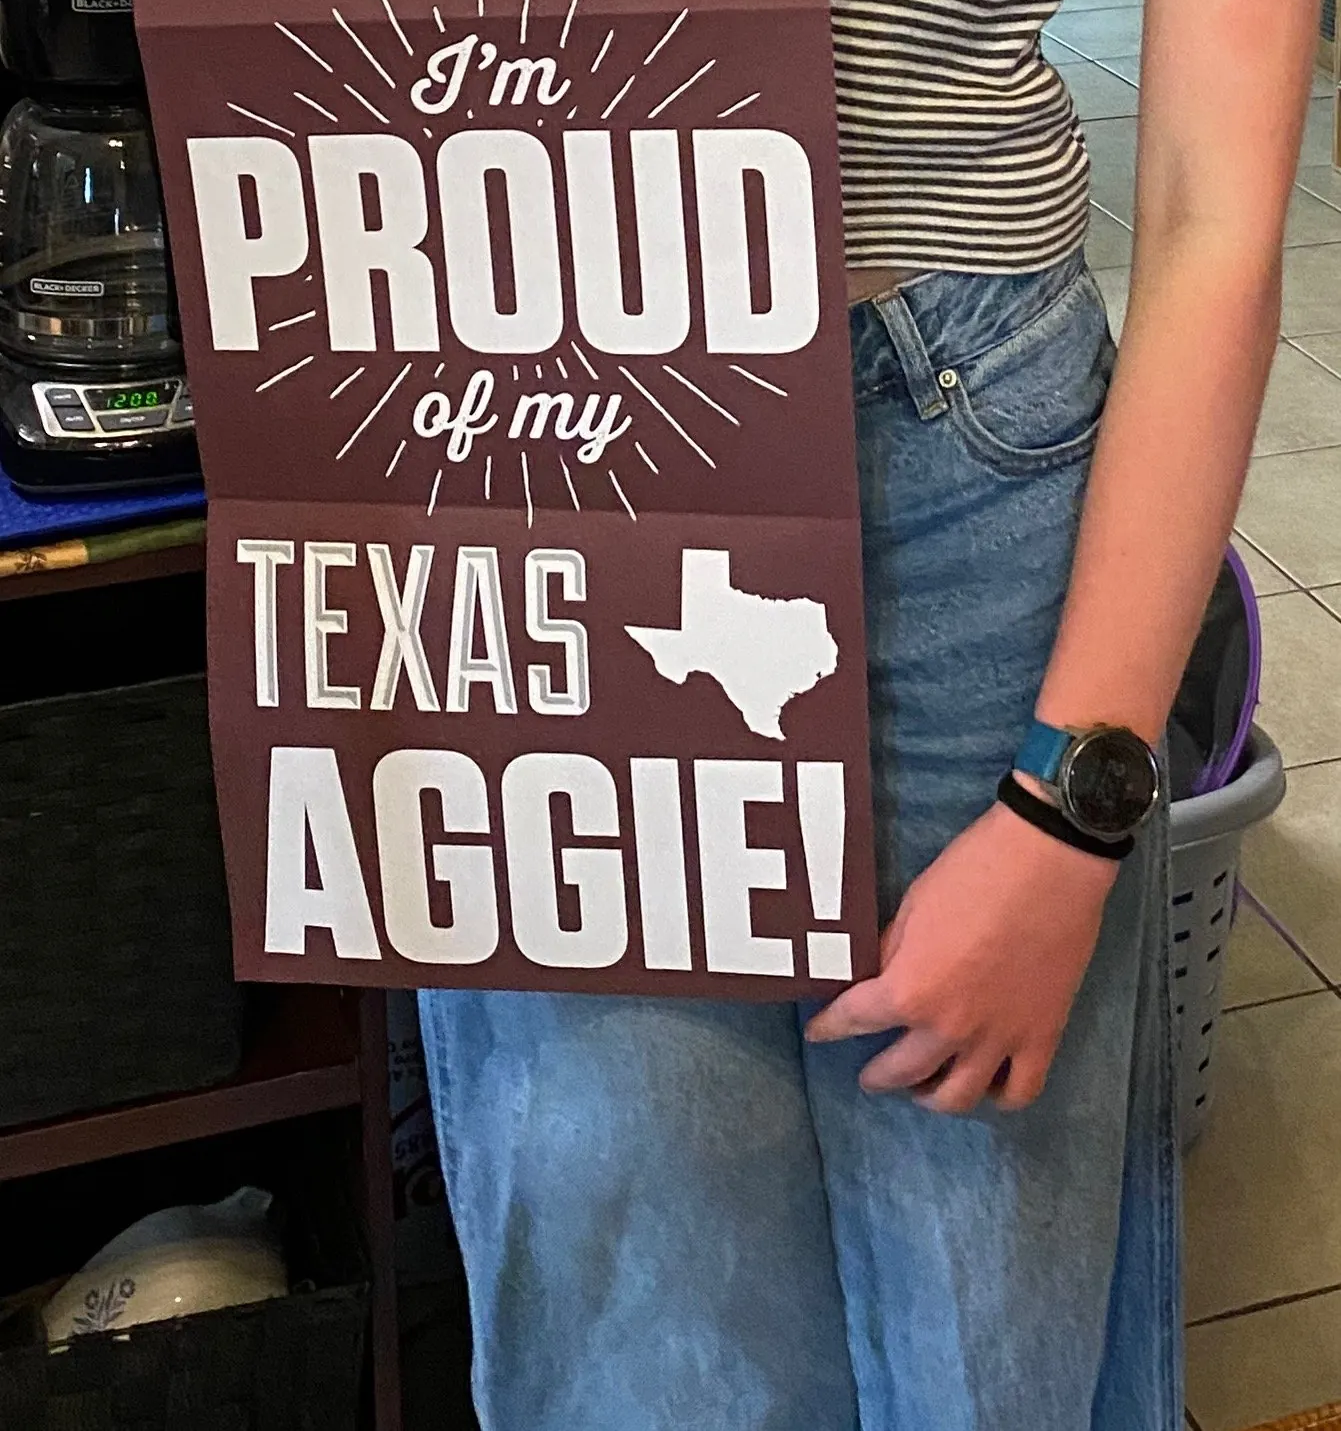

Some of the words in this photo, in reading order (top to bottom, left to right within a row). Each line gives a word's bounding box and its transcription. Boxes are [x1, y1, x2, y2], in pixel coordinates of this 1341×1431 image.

[410, 34, 572, 115] I'm
[186, 129, 820, 355] PROUD
[412, 369, 499, 463] of
[507, 392, 633, 464] my
[236, 539, 591, 716] TEXAS
[264, 746, 853, 982] AGGIE!
